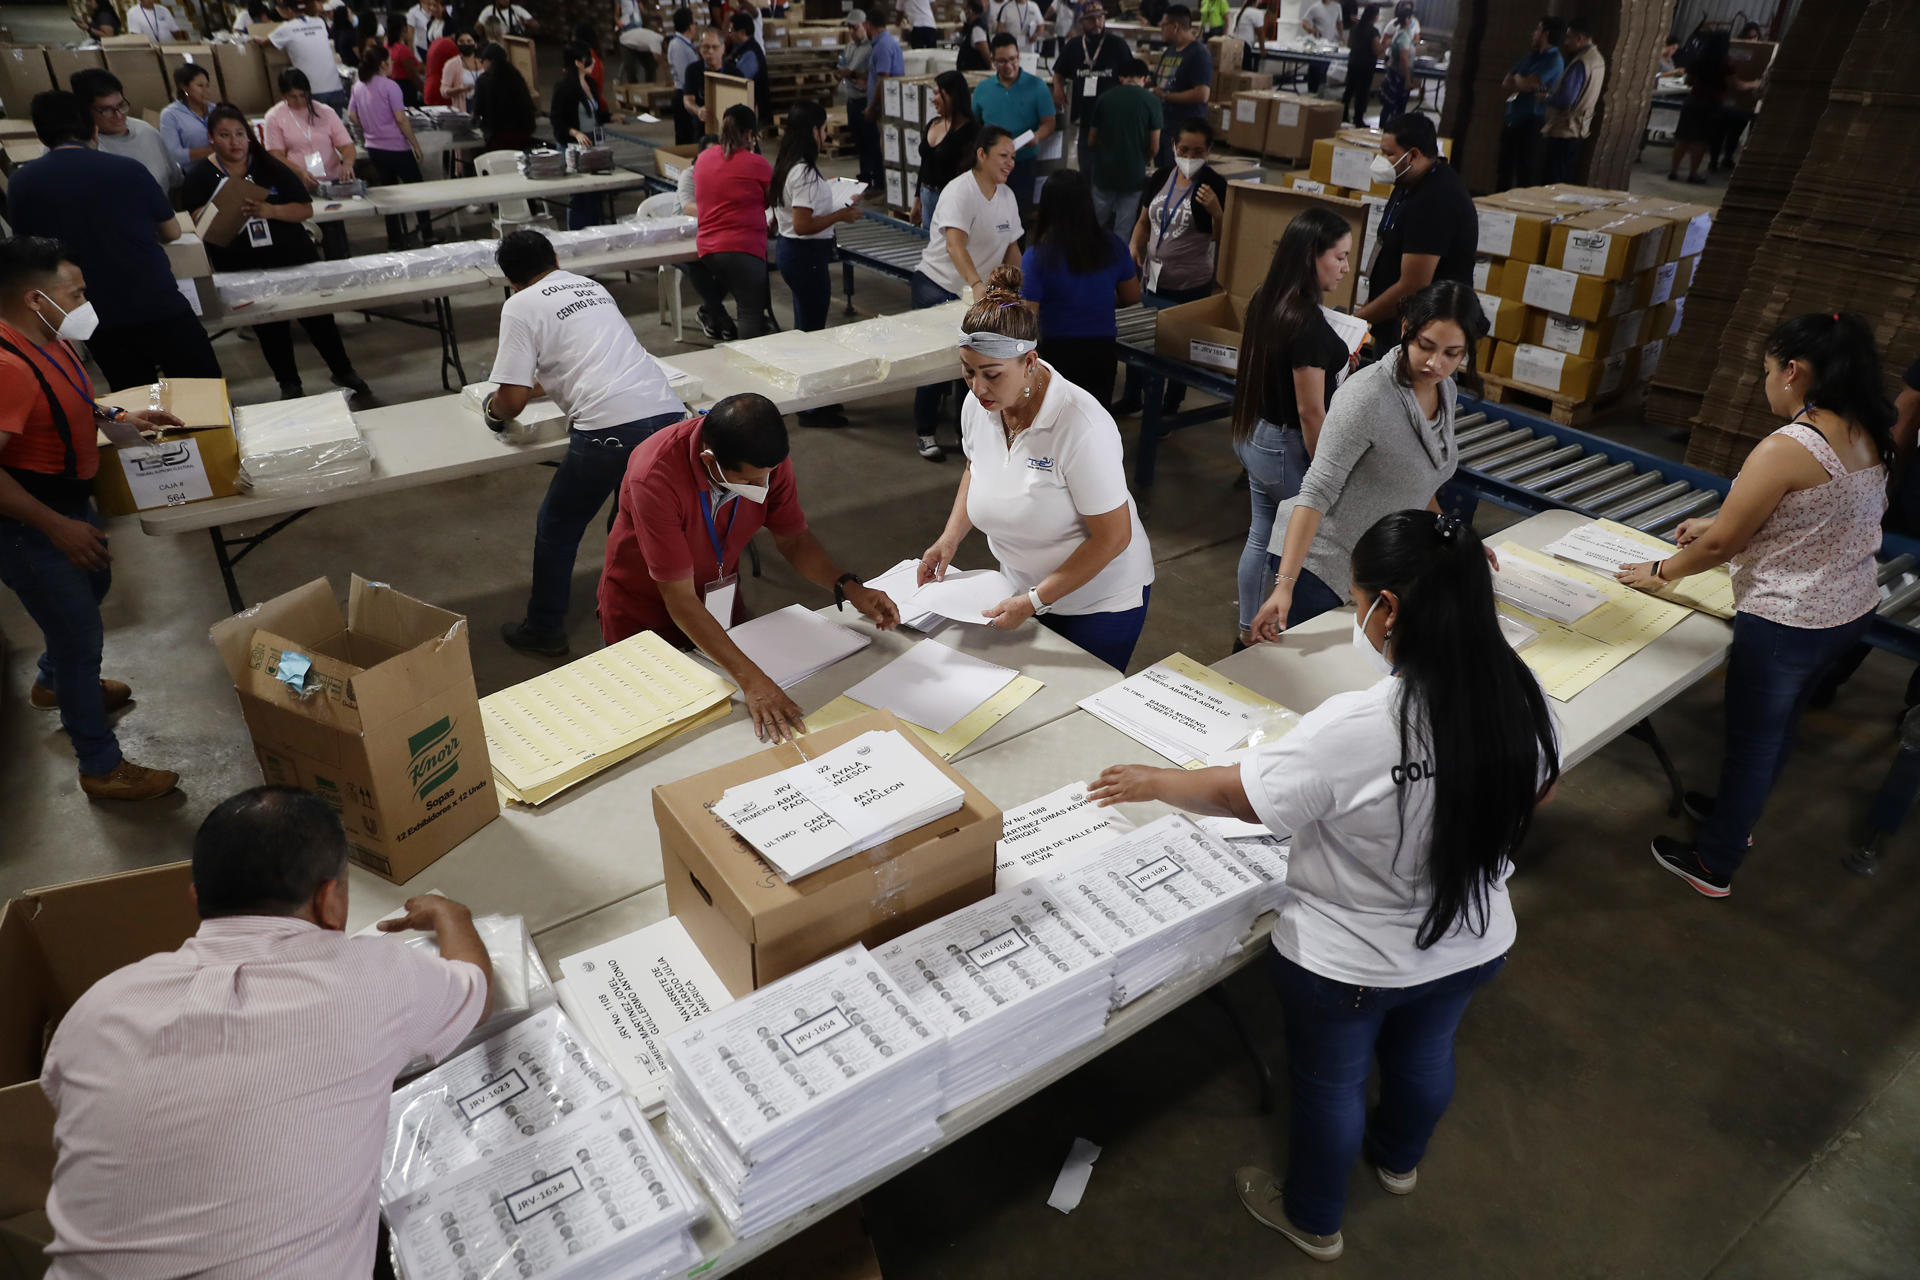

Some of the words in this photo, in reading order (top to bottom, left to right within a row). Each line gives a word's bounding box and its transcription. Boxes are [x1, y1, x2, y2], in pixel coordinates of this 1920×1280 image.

[573, 289, 598, 298] DOE
[556, 300, 587, 320] CENTRO
[159, 482, 178, 490] CAJA
[167, 492, 186, 502] 564
[1142, 674, 1168, 688] PRIMERO
[1168, 686, 1198, 703] ABARCA
[1199, 700, 1215, 710] AIDA
[1215, 708, 1231, 718] LUZ
[1180, 683, 1194, 693] JRV
[1208, 696, 1223, 705] 1690
[1144, 702, 1178, 720] ROBERTO
[1178, 717, 1208, 735] CARLOS
[1150, 698, 1175, 714] BAIRES
[1175, 711, 1206, 728] MORENO
[408, 738, 460, 786] Knorr
[834, 764, 872, 787] NCESCA
[736, 804, 776, 826] PRIMERO
[832, 760, 863, 780] AYALA
[774, 784, 791, 796] JRV
[816, 764, 831, 775] 22
[426, 788, 456, 811] Sopas
[861, 781, 905, 808] APOLEON
[396, 832, 408, 842] 12
[408, 804, 452, 836] Exhibidores
[458, 792, 468, 802] 12
[468, 780, 487, 796] Unds
[1002, 820, 1041, 838] MARTINEZ
[1041, 809, 1066, 823] DIMAS
[1014, 814, 1028, 822] No:
[1028, 806, 1048, 817] 1688
[1004, 826, 1042, 844] ENRIQUE
[1020, 845, 1053, 862] RIVERA
[1052, 840, 1066, 848] DE
[1065, 828, 1092, 843] VALLE
[1092, 820, 1111, 832] ANA
[996, 860, 1015, 872] TIMO
[1026, 852, 1054, 866] SILVIA
[1138, 864, 1169, 884] JRV-1682
[979, 939, 1015, 960] JRV-1668
[608, 959, 632, 992] ANTONIO
[651, 966, 663, 978] DE
[658, 956, 675, 976] JULIA
[608, 976, 626, 1000] JOVEL
[658, 978, 692, 1022] NAVARRETE
[670, 978, 702, 1018] ALVARADO
[686, 979, 712, 1014] AMERICA
[598, 994, 614, 1011] 1108
[628, 992, 660, 1035] GUILLERMO
[616, 1023, 632, 1040] JRV
[621, 1002, 648, 1039] MARTINEZ
[796, 1018, 836, 1045] JRV-1654
[469, 1082, 511, 1110] JRV-1623
[516, 1181, 566, 1212] JRV-1634
